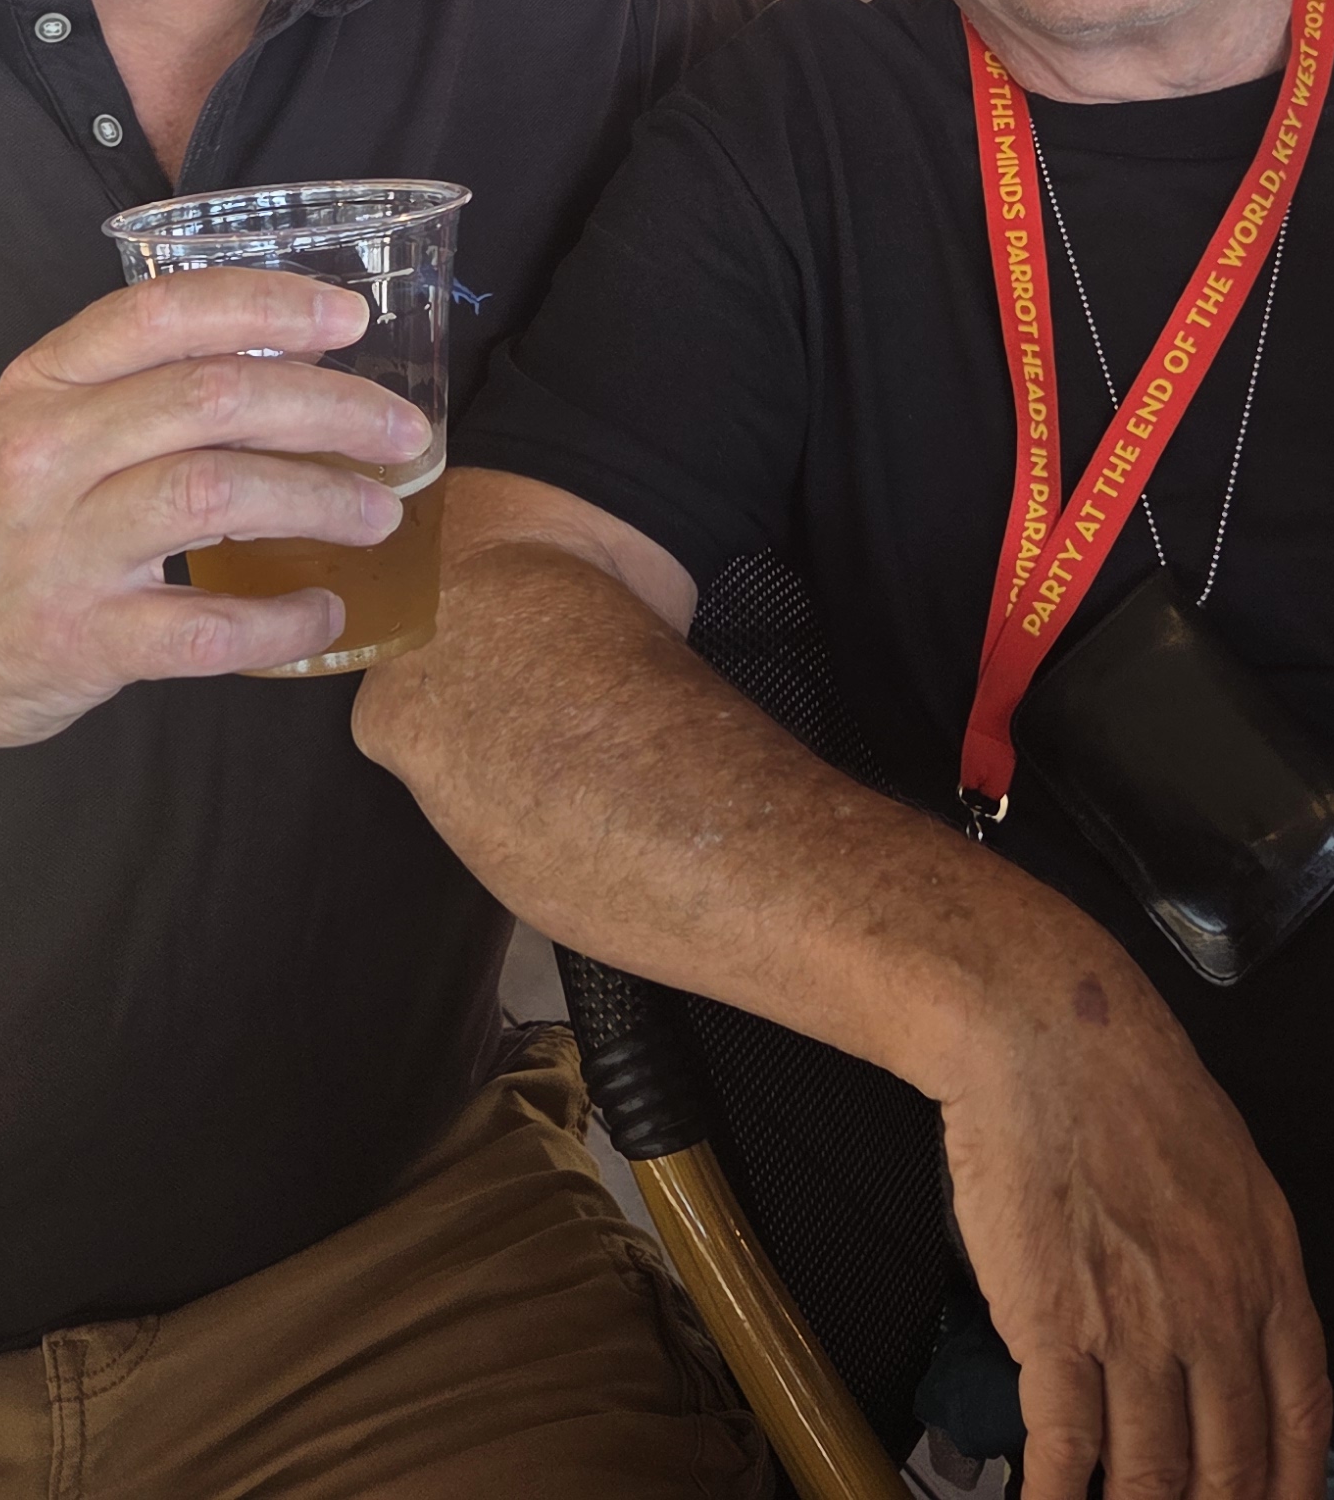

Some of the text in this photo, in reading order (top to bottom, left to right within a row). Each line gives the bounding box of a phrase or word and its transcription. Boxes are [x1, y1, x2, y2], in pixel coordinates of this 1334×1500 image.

[984, 51, 1008, 81] OF
[989, 85, 1015, 131] THE
[994, 135, 1025, 219] MINDS
[1005, 230, 1039, 339] PARROT
[1022, 538, 1084, 637] PARTY
[1075, 500, 1105, 543] AT
[1093, 439, 1141, 498] THE
[1126, 378, 1173, 439] END
[1163, 330, 1197, 374] OF
[1185, 271, 1234, 328] THE
[1217, 169, 1287, 267] WORLD,
[1271, 106, 1302, 165] KEY
[1291, 39, 1318, 107] WEST
[1021, 343, 1048, 441] HEADS
[1030, 448, 1048, 477] IN
